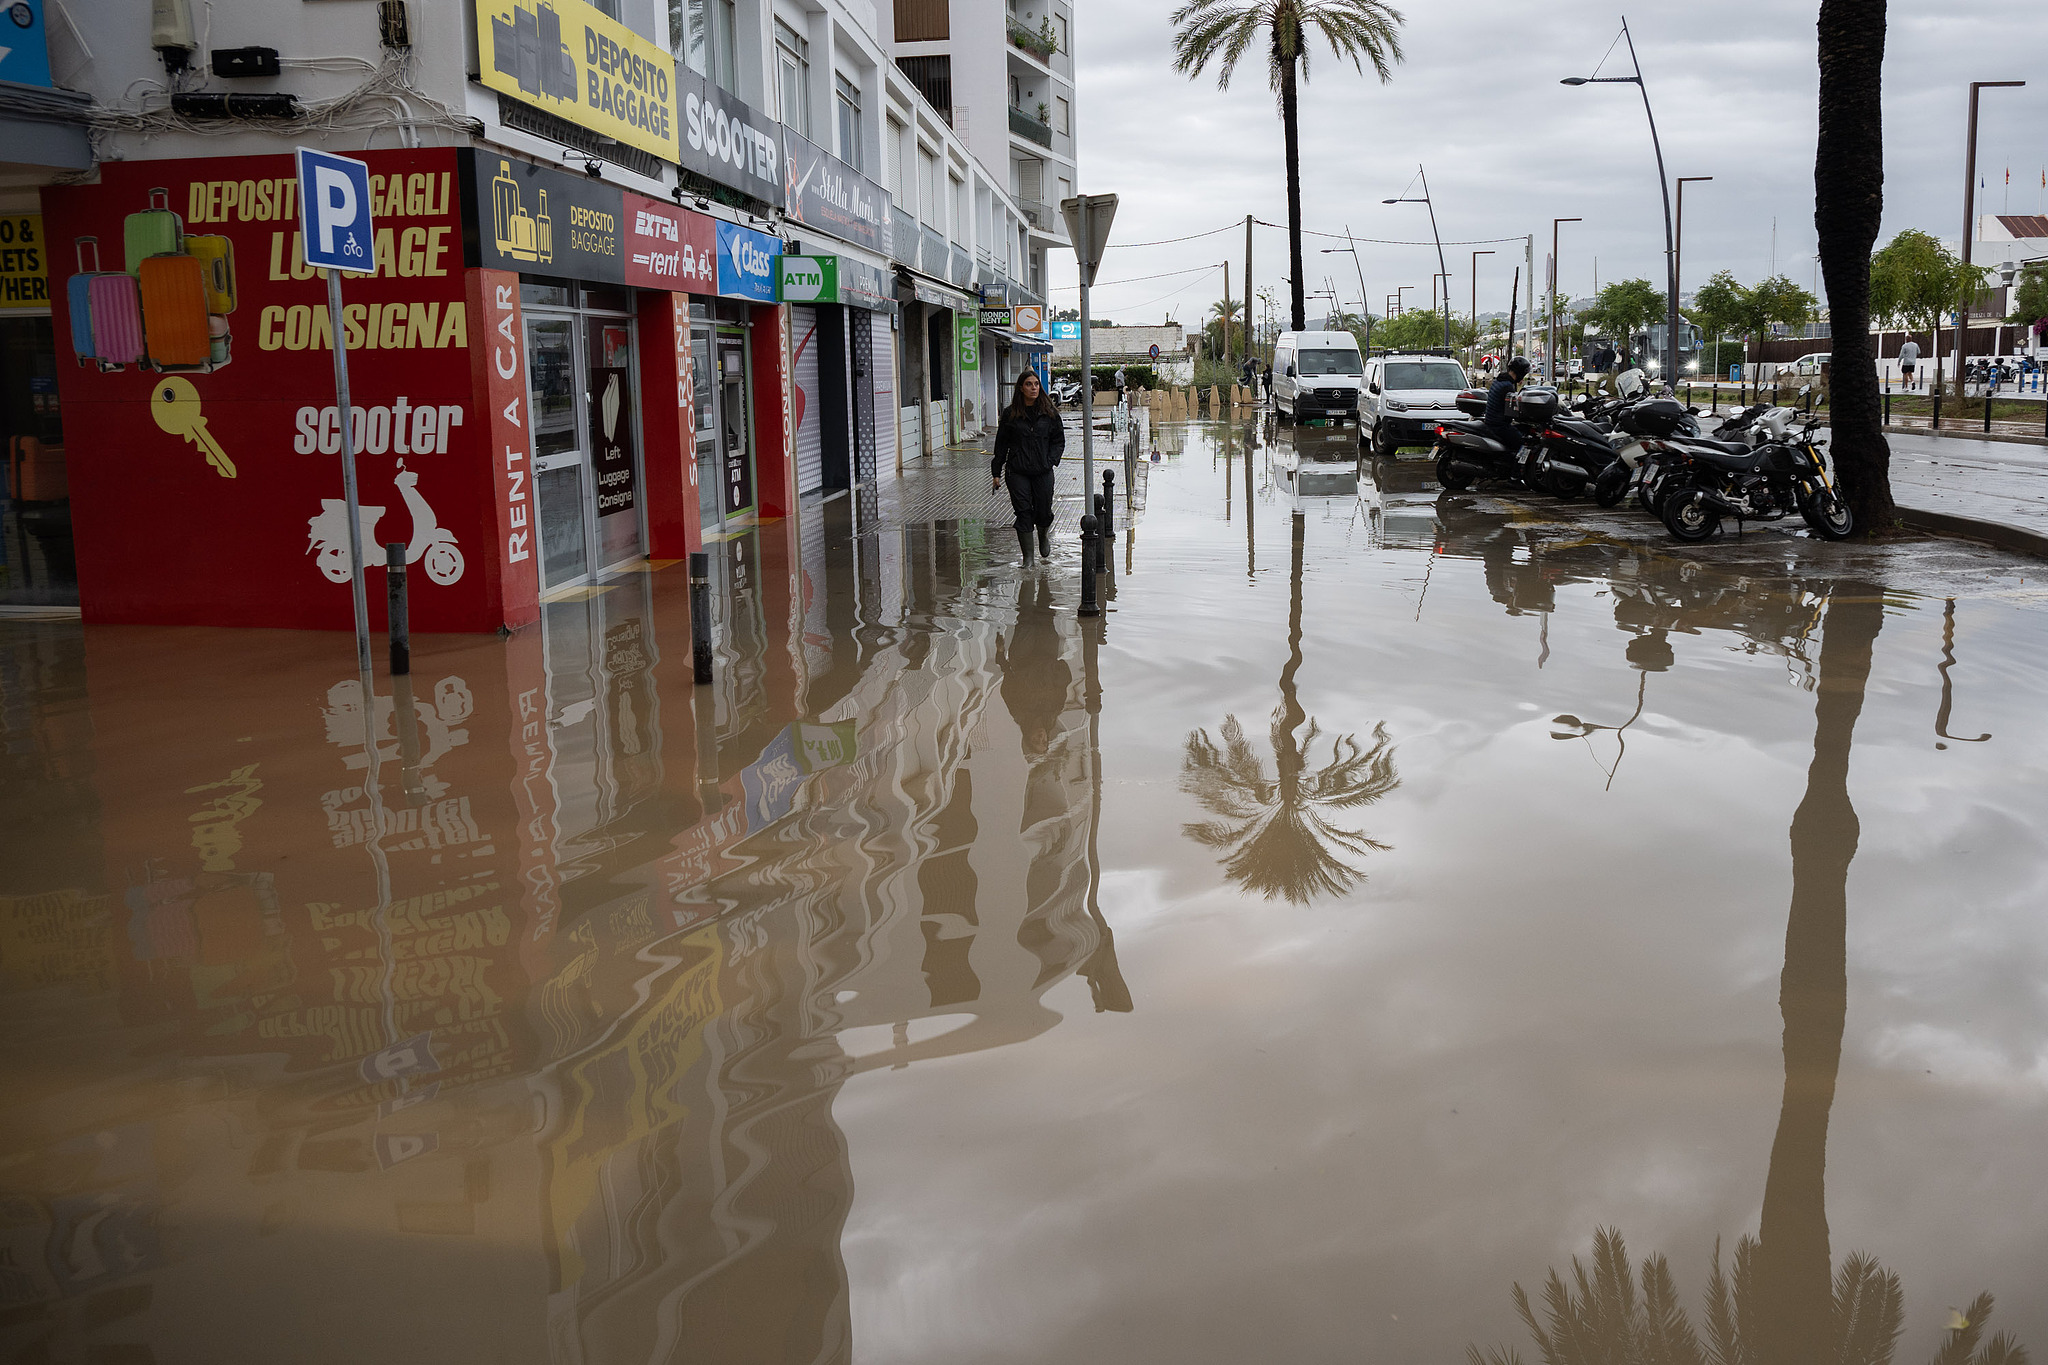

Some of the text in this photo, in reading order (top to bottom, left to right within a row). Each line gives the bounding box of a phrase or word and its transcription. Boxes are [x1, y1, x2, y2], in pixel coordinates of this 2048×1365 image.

[584, 25, 668, 103] DEPOSITO
[587, 68, 670, 141] BAGGAGE
[686, 92, 778, 186] SCOOTER
[188, 178, 301, 223] DEPOSIT
[315, 165, 357, 254] P
[571, 205, 615, 233] DEPOSITO
[571, 230, 615, 256] BAGGAGE
[635, 210, 679, 242] EXTRA
[0, 248, 39, 272] ETS
[648, 250, 679, 277] rent
[741, 240, 770, 278] Class
[784, 273, 820, 286] ATM
[259, 302, 469, 351] CONSIGNA
[962, 325, 976, 364] CAR
[675, 300, 688, 408] RENT
[682, 301, 698, 486] SCOOTER
[780, 313, 790, 458] CONSIGNA
[294, 396, 464, 455] scooter
[496, 284, 529, 564] RENT A CAR
[605, 445, 621, 461] Left
[598, 469, 630, 487] Luggage
[599, 490, 633, 509] Consigna
